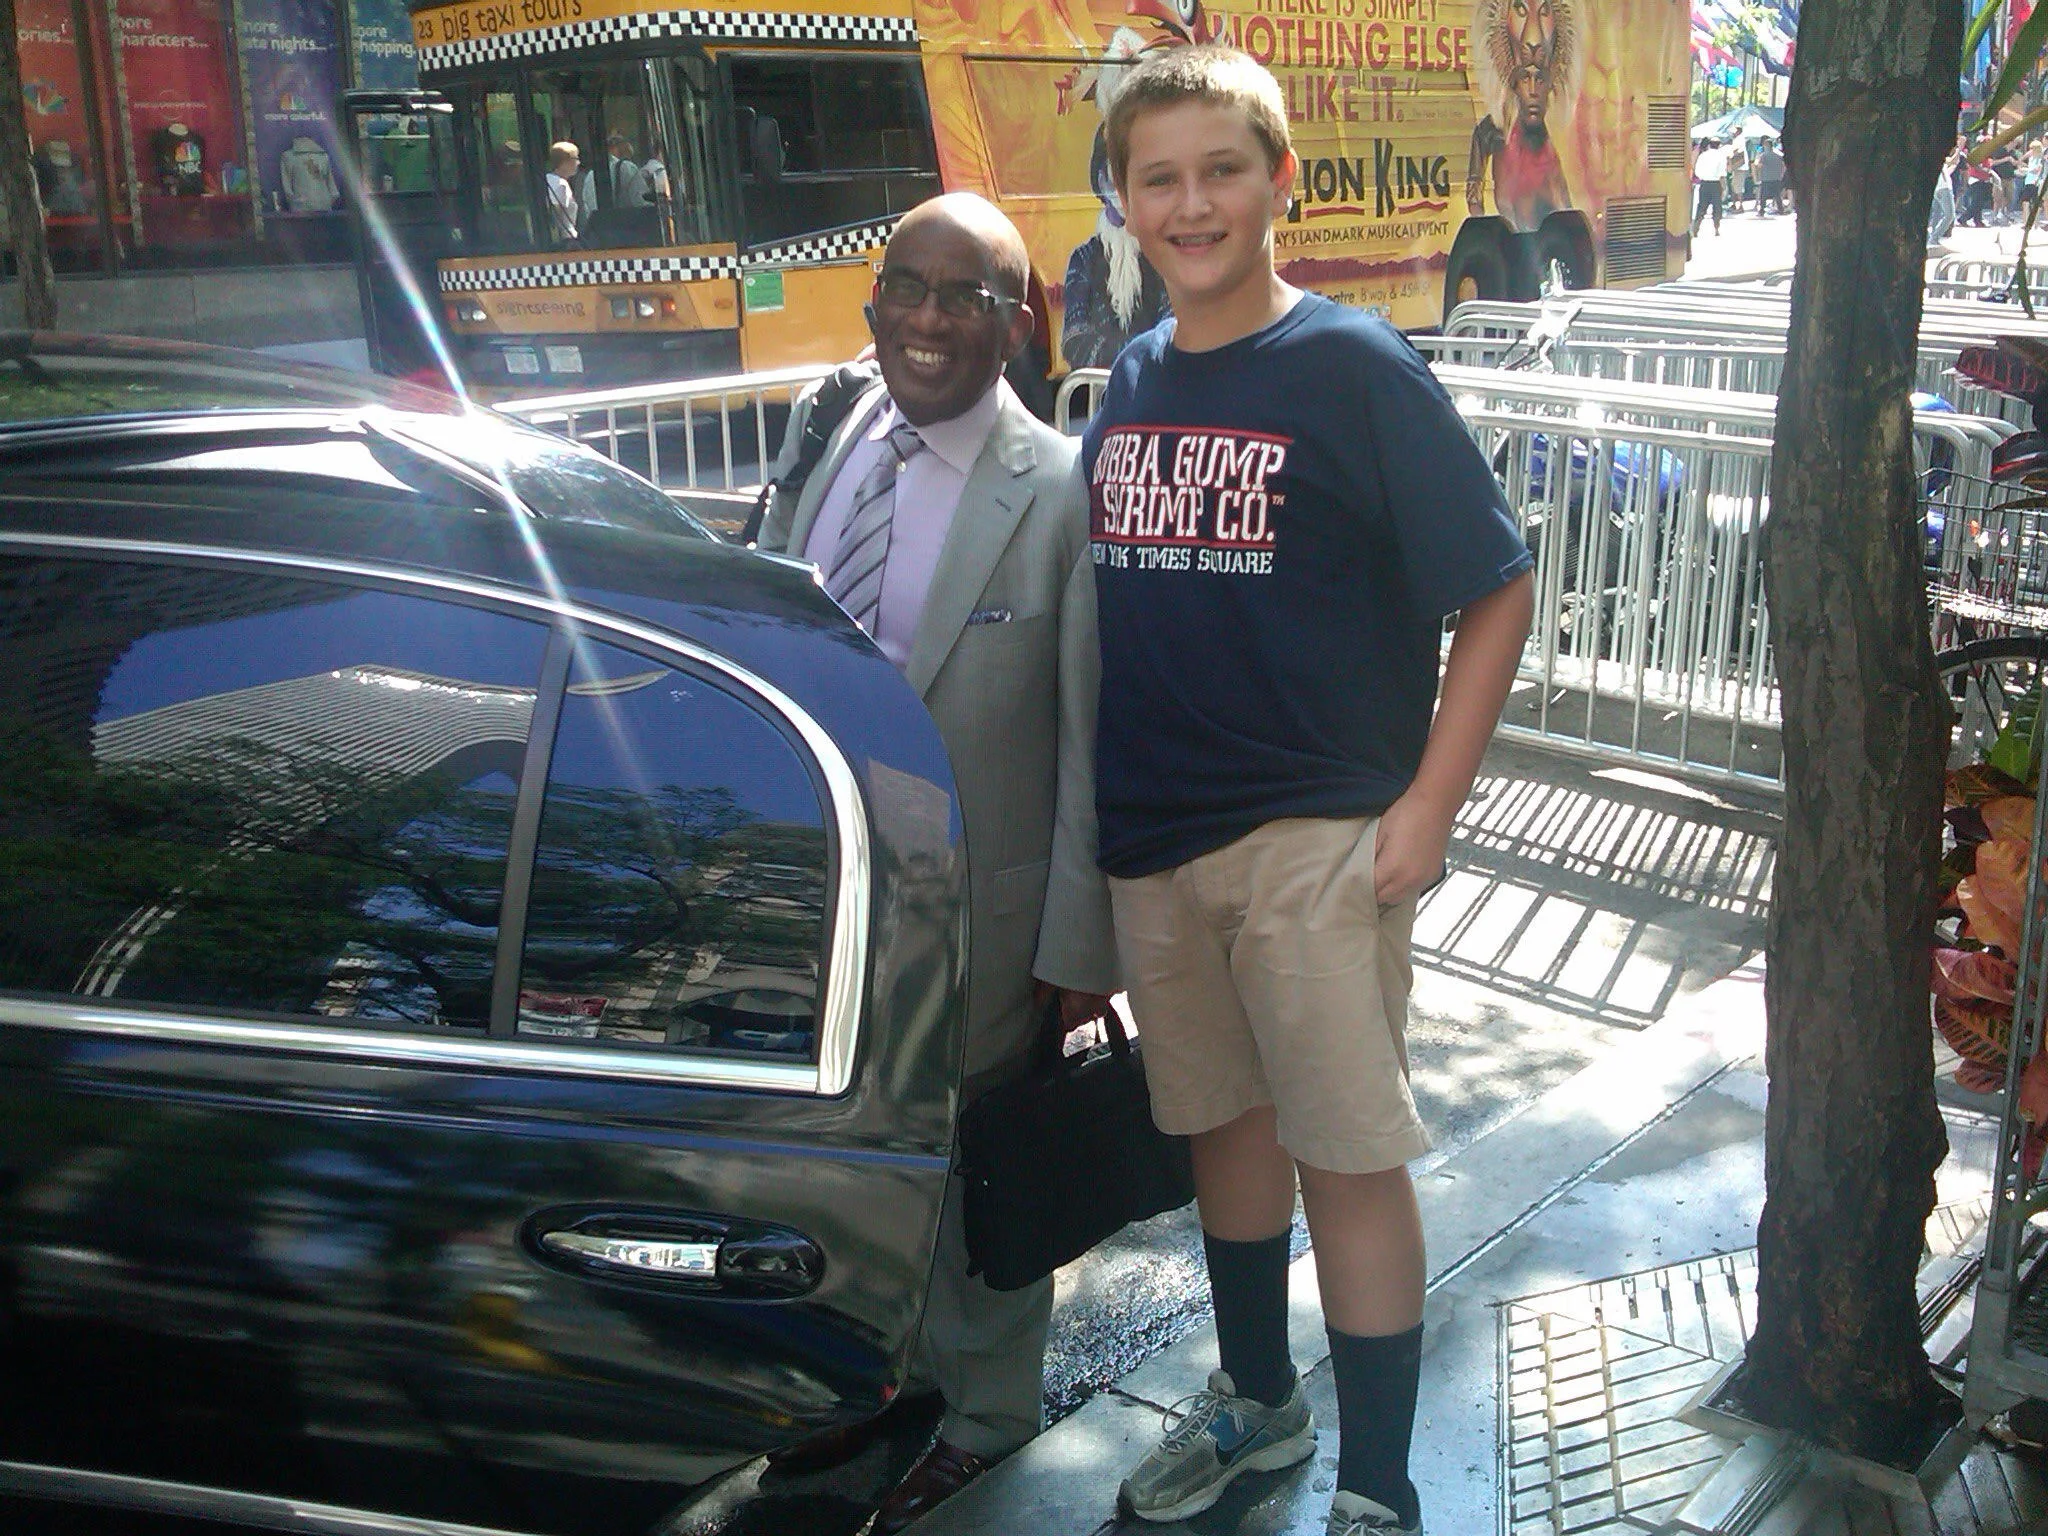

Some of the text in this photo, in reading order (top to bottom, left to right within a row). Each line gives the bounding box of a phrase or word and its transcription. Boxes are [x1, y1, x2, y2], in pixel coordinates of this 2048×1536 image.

[120, 34, 210, 48] haracters...
[418, 0, 582, 41] 23 big taxi tours
[1403, 25, 1468, 72] ELSE
[1287, 73, 1360, 122] LIKE
[1374, 138, 1450, 218] KING
[1300, 225, 1365, 245] LANDMARK
[1366, 221, 1414, 241] MUSICAL
[1417, 220, 1449, 238] EVENT
[1172, 435, 1287, 491] GUMP
[1216, 490, 1275, 541] CO.
[1136, 546, 1191, 570] TIMES
[1197, 548, 1274, 575] SQUARE
